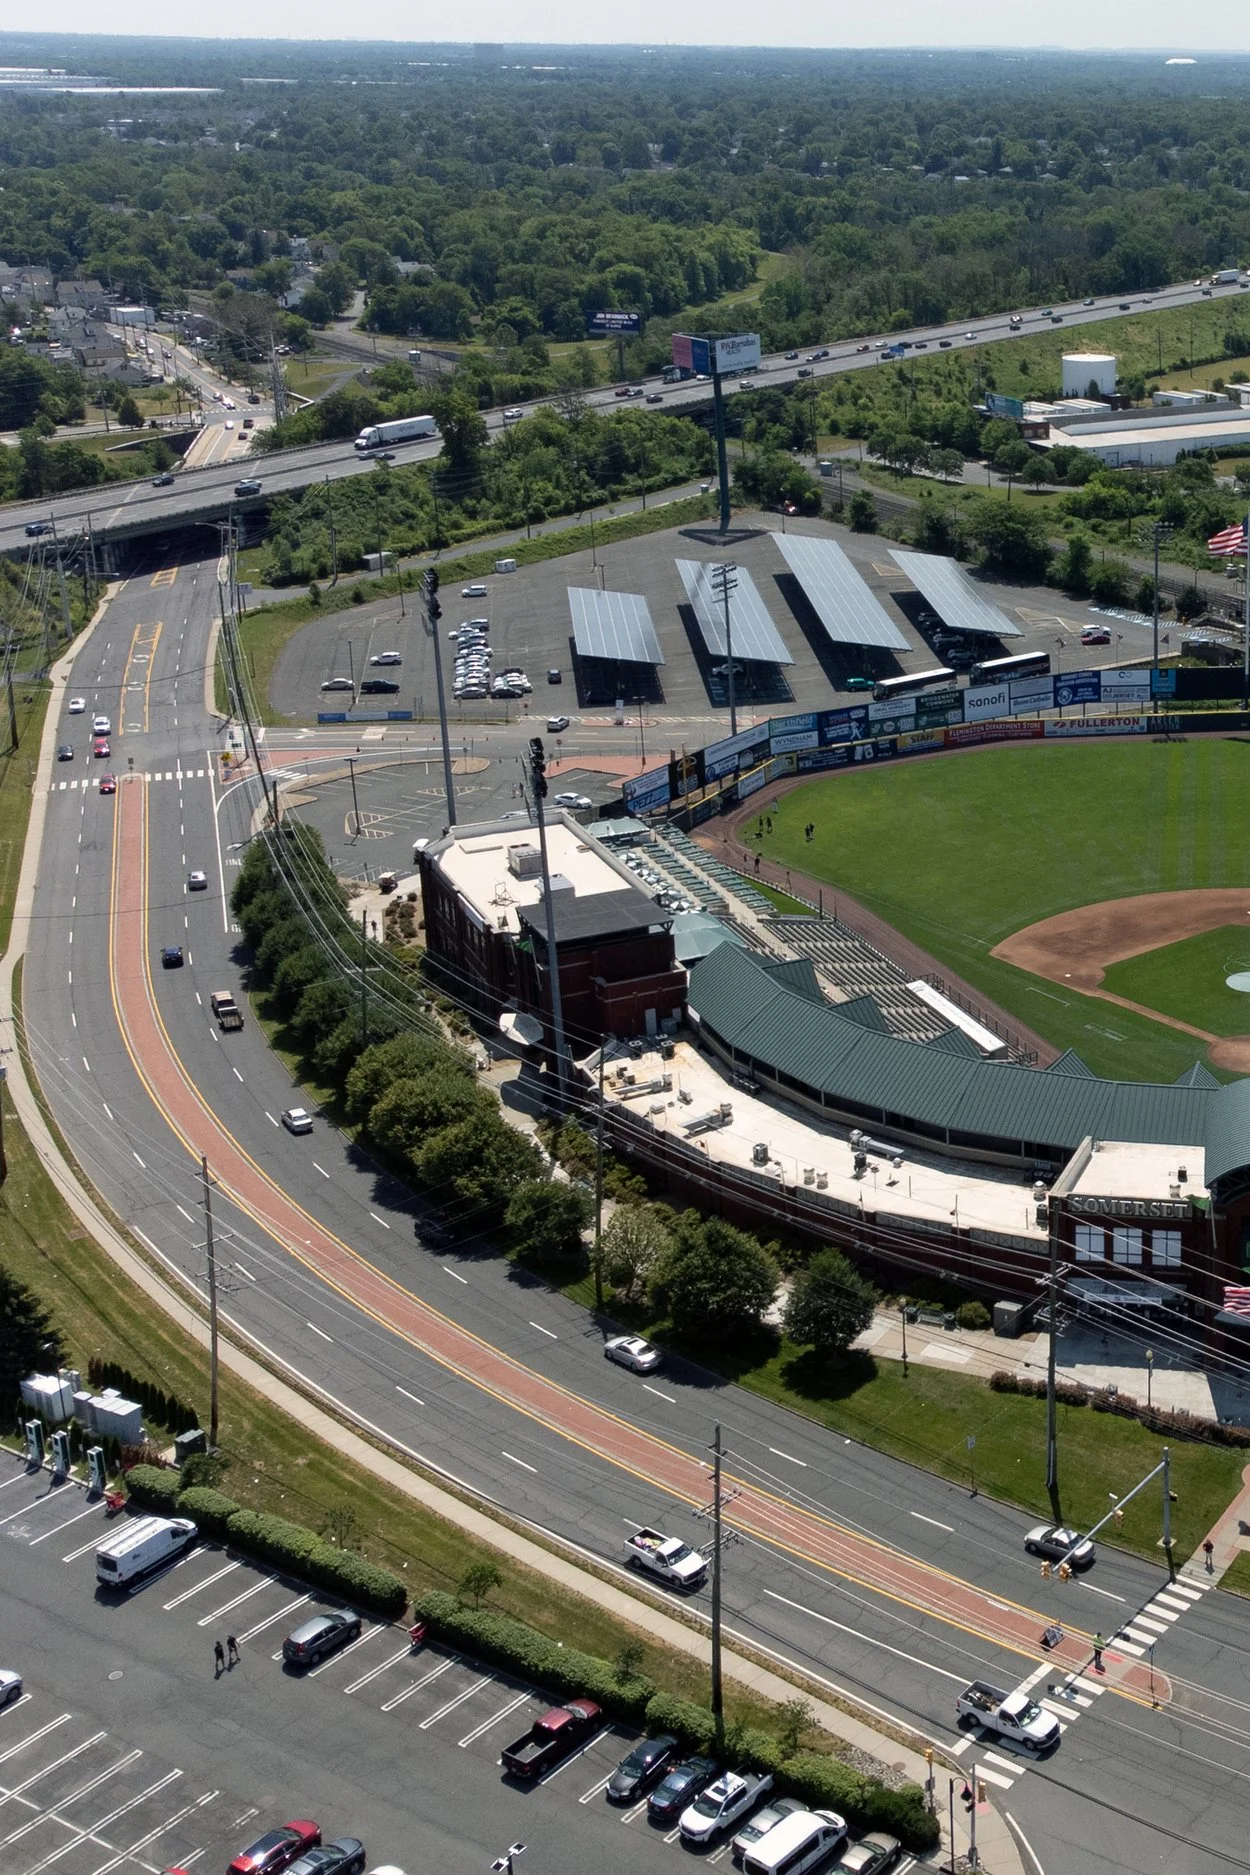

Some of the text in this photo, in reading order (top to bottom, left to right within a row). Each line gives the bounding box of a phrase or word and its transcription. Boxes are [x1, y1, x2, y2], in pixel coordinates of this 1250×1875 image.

[968, 692, 1006, 708] sanofi
[949, 721, 1041, 737] FLEMINGTON DEPARTMENT STORE
[1070, 717, 1140, 728] FULLERTON
[774, 733, 813, 745] WYNDHAM
[1071, 1197, 1188, 1218] SOMERSET
